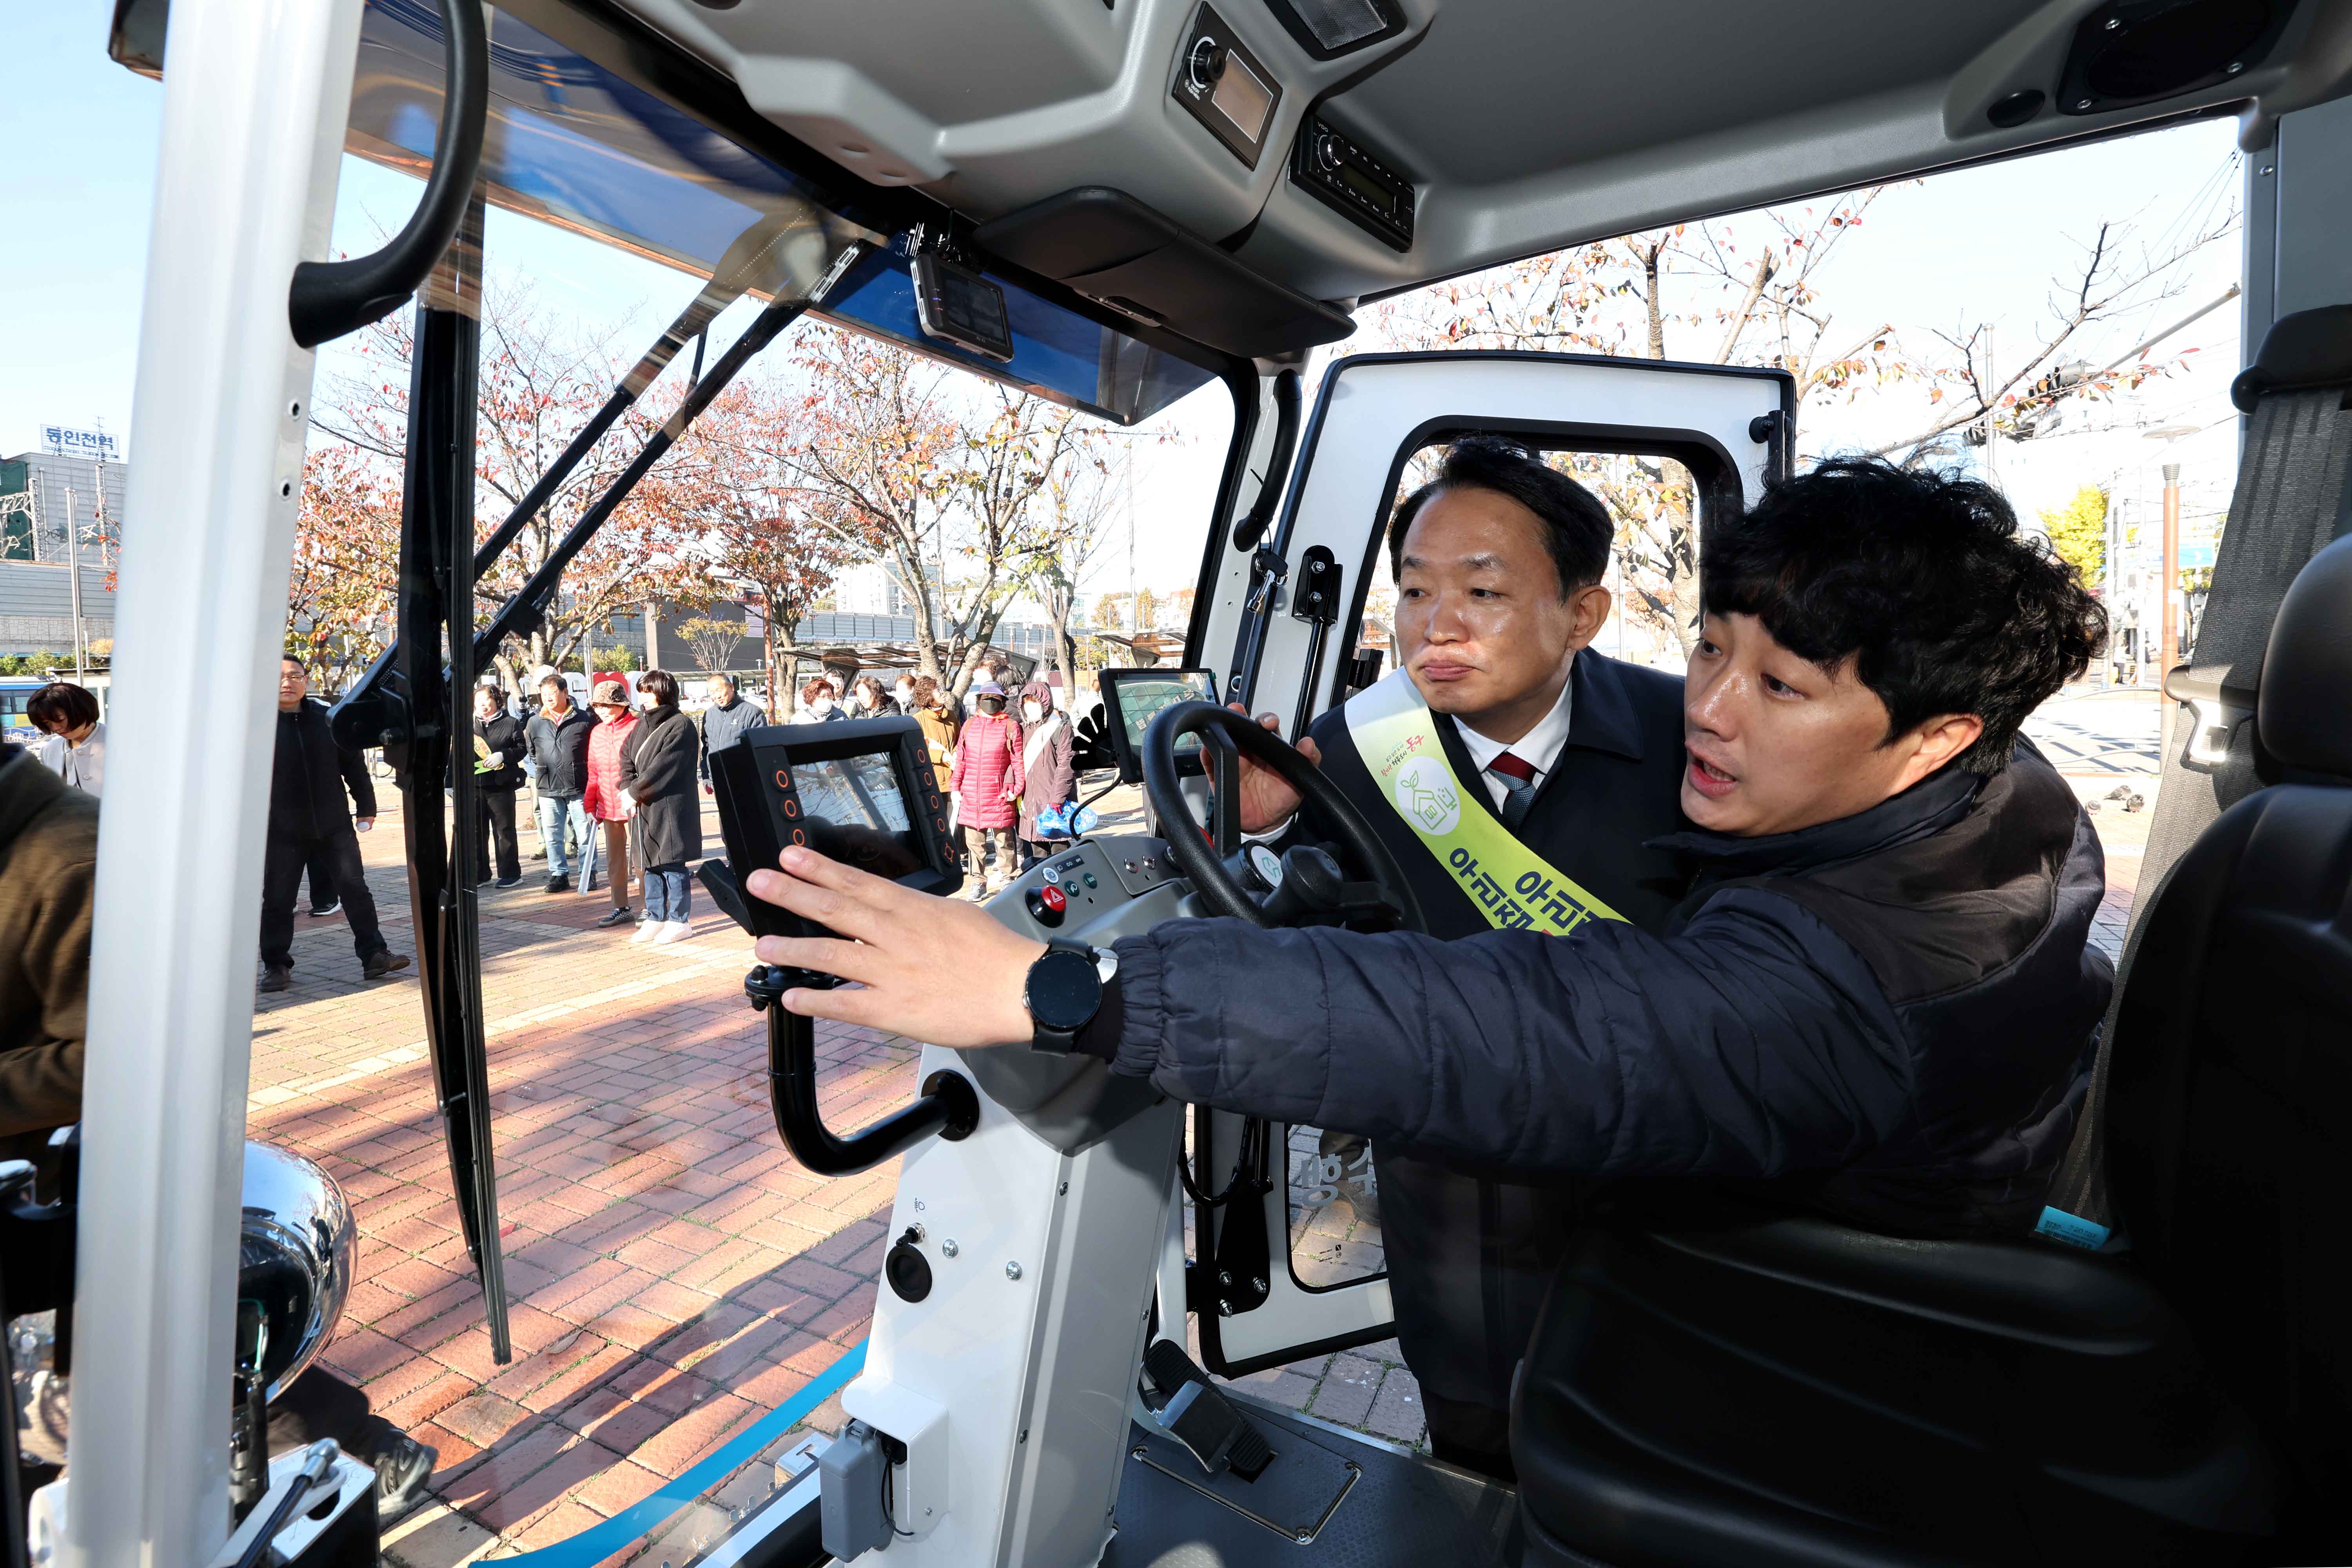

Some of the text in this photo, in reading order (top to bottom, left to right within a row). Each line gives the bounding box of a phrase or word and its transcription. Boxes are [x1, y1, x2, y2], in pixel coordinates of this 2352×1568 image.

[1318, 122, 1328, 132] VDO
[47, 428, 113, 450] 동인천역
[1406, 735, 1425, 752] 동구
